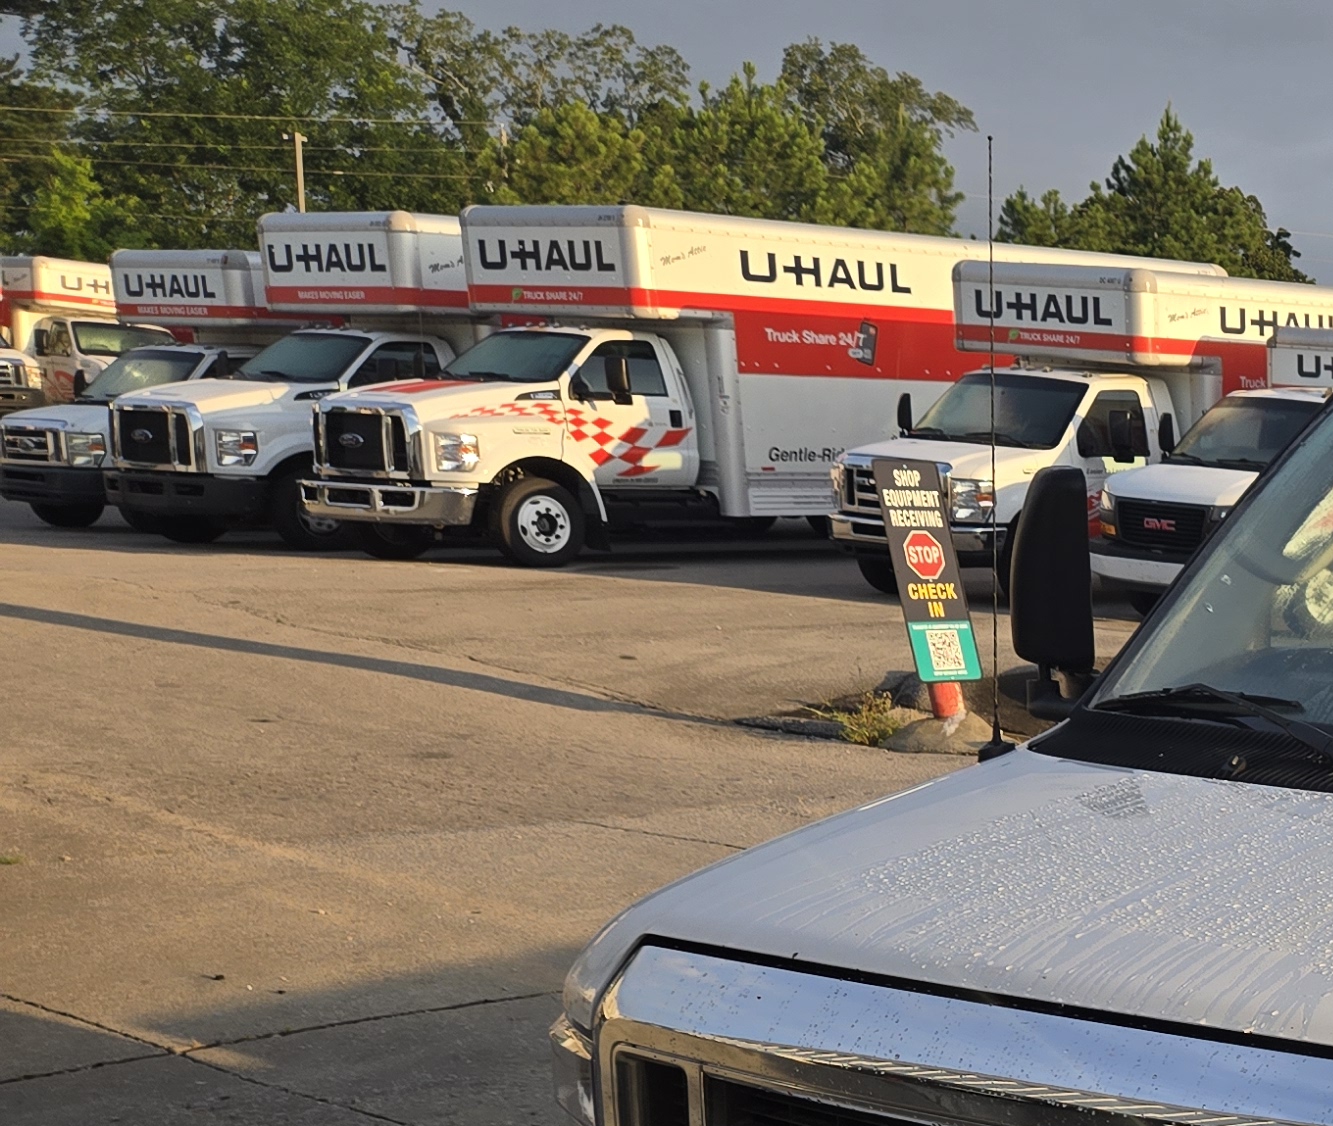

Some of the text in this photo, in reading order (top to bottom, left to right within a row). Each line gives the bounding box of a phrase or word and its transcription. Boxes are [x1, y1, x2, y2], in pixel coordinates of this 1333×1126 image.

[267, 243, 386, 273] U-HAUL
[478, 239, 616, 272] U-HAUL
[739, 250, 912, 294] U-HAUL
[123, 273, 216, 299] U-HAUL
[523, 290, 545, 301] TRUCK
[974, 288, 1113, 326] U-HAUL
[764, 327, 801, 344] Truck
[802, 329, 837, 346] Share
[1019, 331, 1042, 342] TRUCK
[1042, 333, 1065, 343] SHARE
[1239, 376, 1266, 388] Truck
[893, 469, 921, 487] SHOP
[882, 489, 940, 507] EQUIPMENT
[889, 509, 943, 528] RECEIVING
[1143, 517, 1176, 531] GMC
[908, 545, 940, 564] STOP
[907, 582, 958, 600] CHECK
[927, 601, 945, 618] IN
